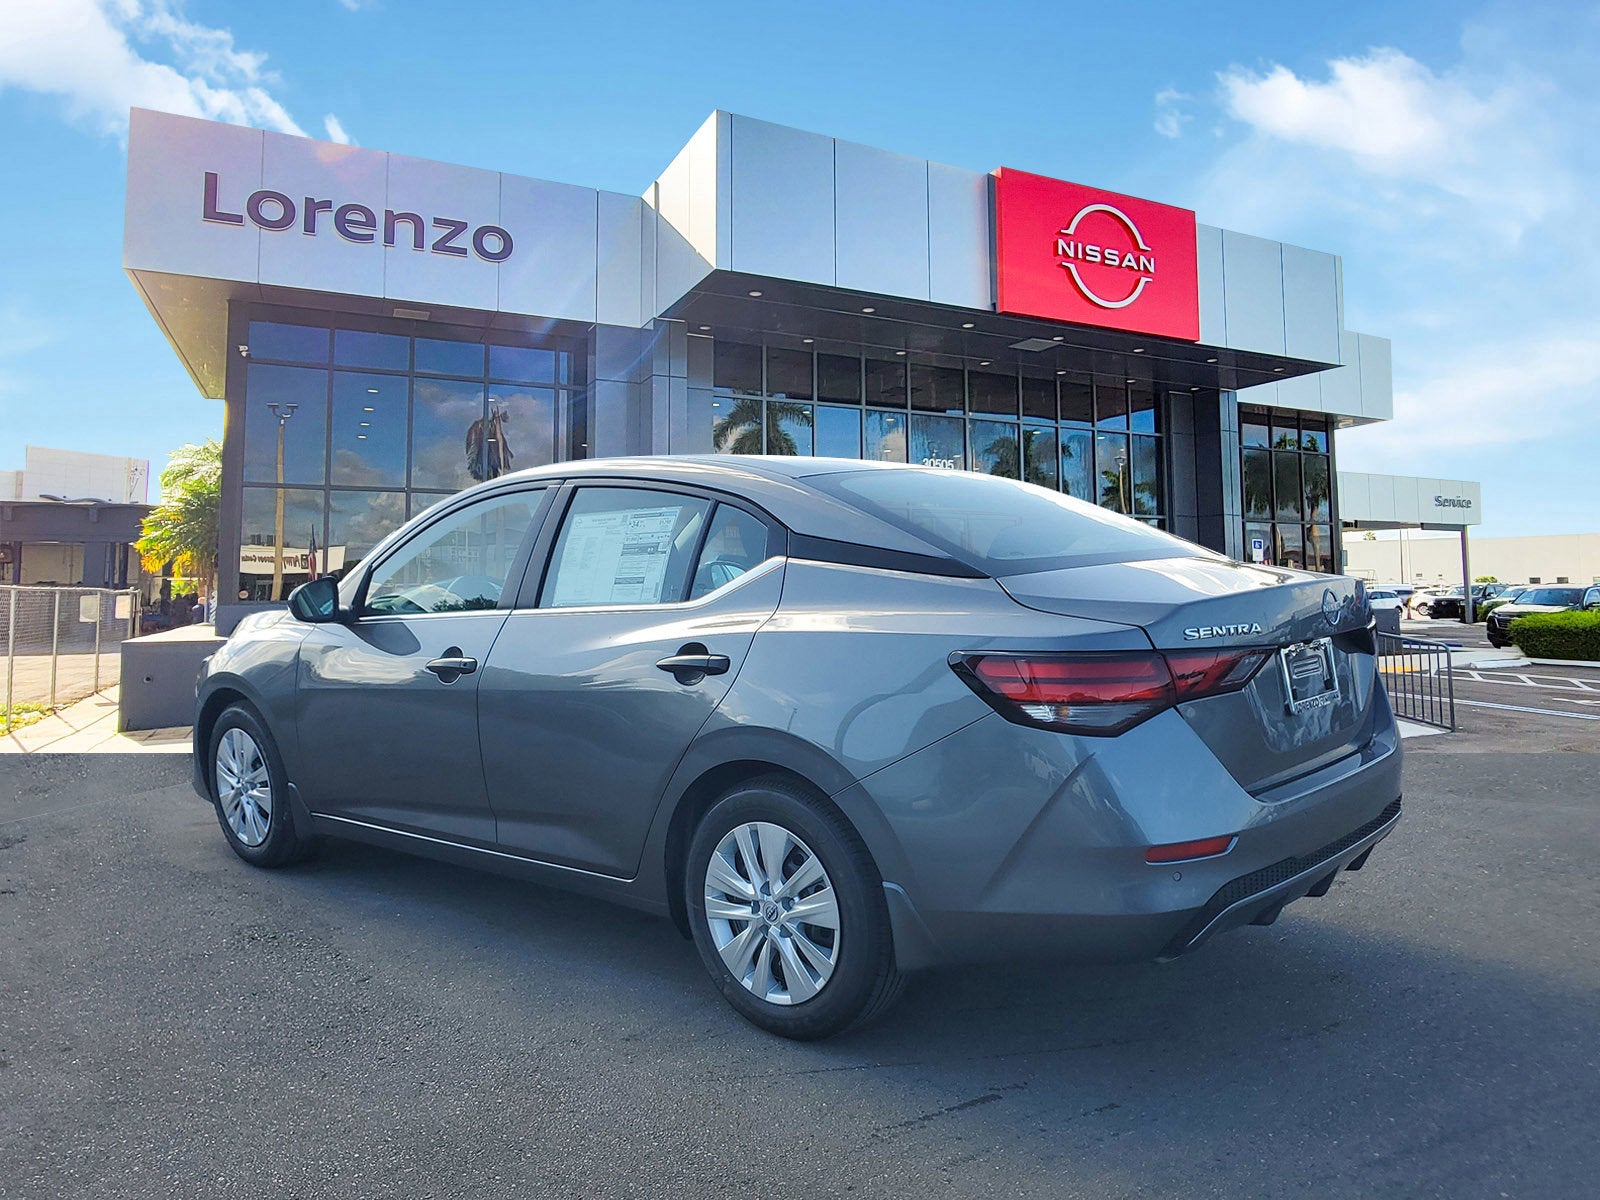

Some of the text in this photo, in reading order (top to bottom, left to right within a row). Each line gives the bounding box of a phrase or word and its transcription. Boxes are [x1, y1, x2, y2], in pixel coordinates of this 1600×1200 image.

[202, 171, 514, 262] Lorenzo
[1057, 238, 1155, 273] NISSAN
[1434, 495, 1472, 508] Service
[1183, 623, 1262, 641] SENTRA
